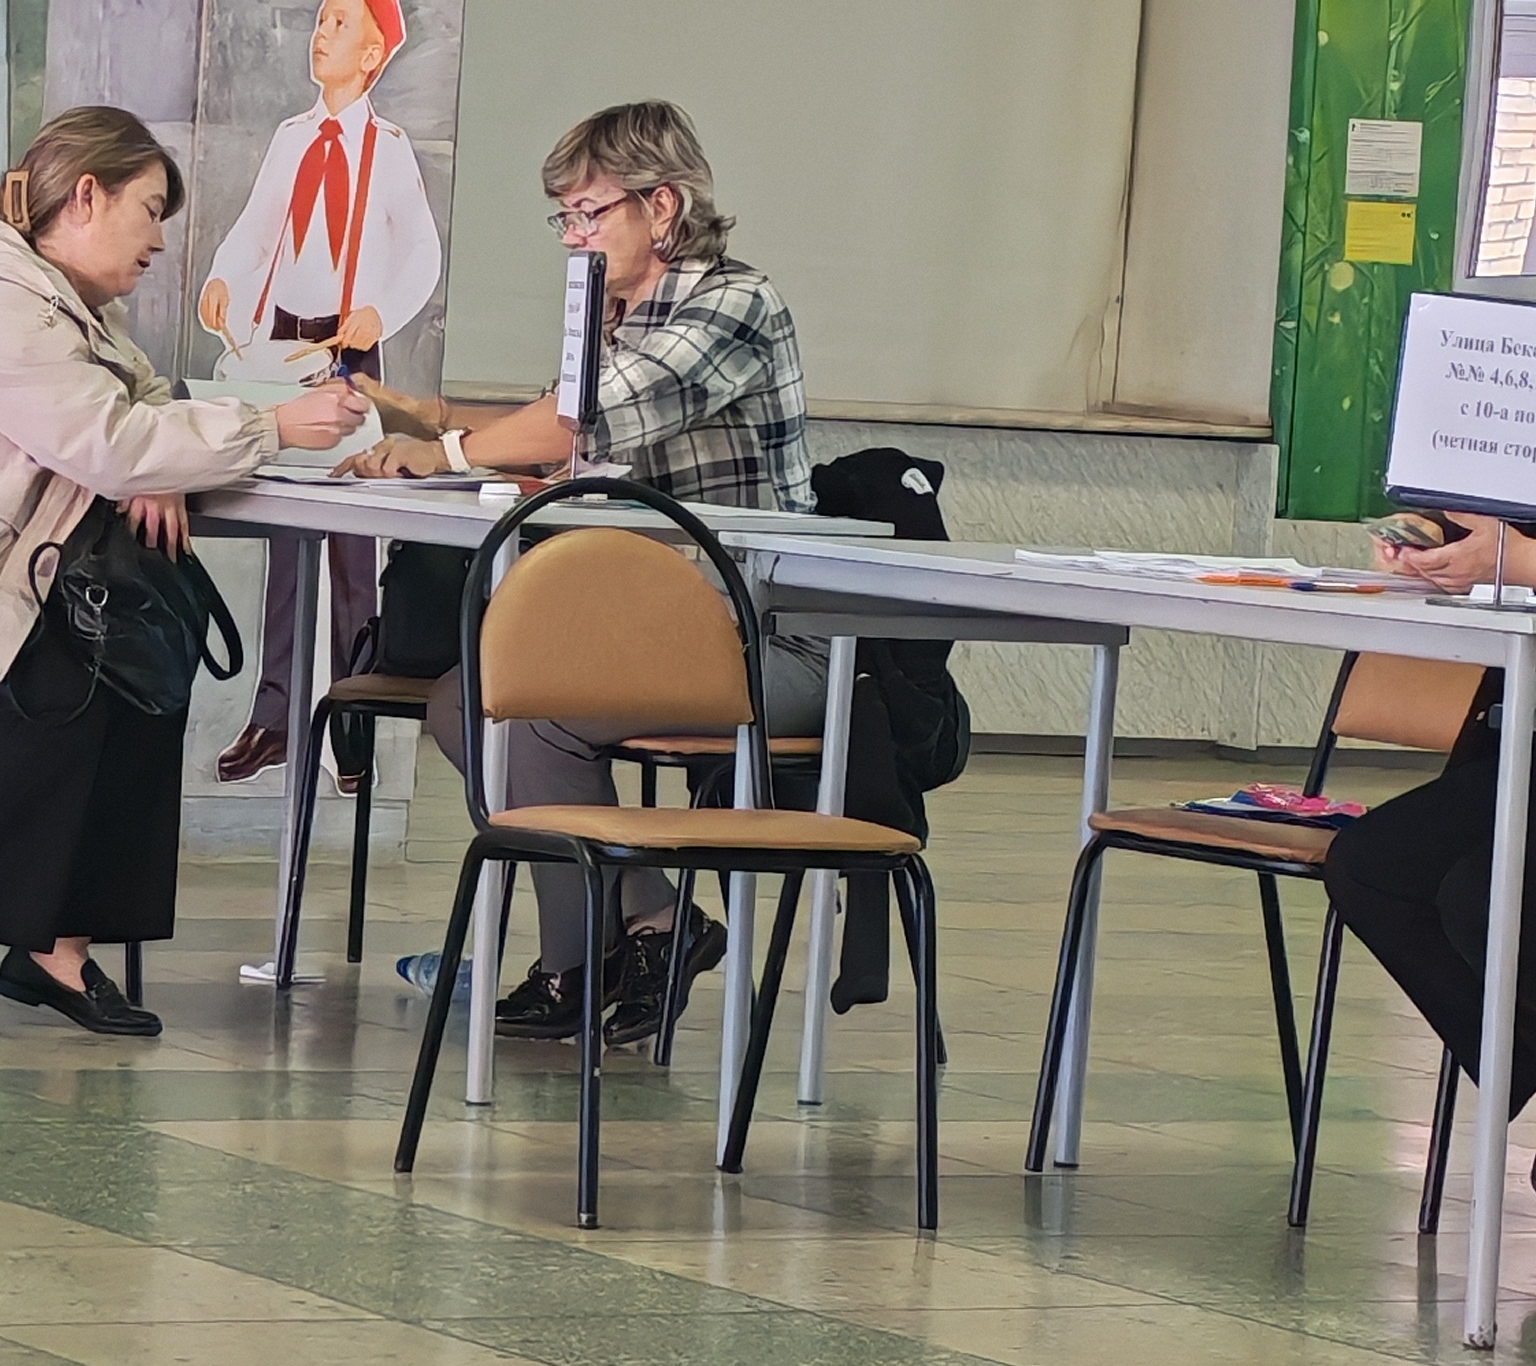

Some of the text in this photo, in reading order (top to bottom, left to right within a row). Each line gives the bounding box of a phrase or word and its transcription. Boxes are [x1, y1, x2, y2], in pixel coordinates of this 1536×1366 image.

[1440, 329, 1495, 354] Улица
[1460, 399, 1535, 424] с 10-а по
[1431, 429, 1499, 455] (четная
